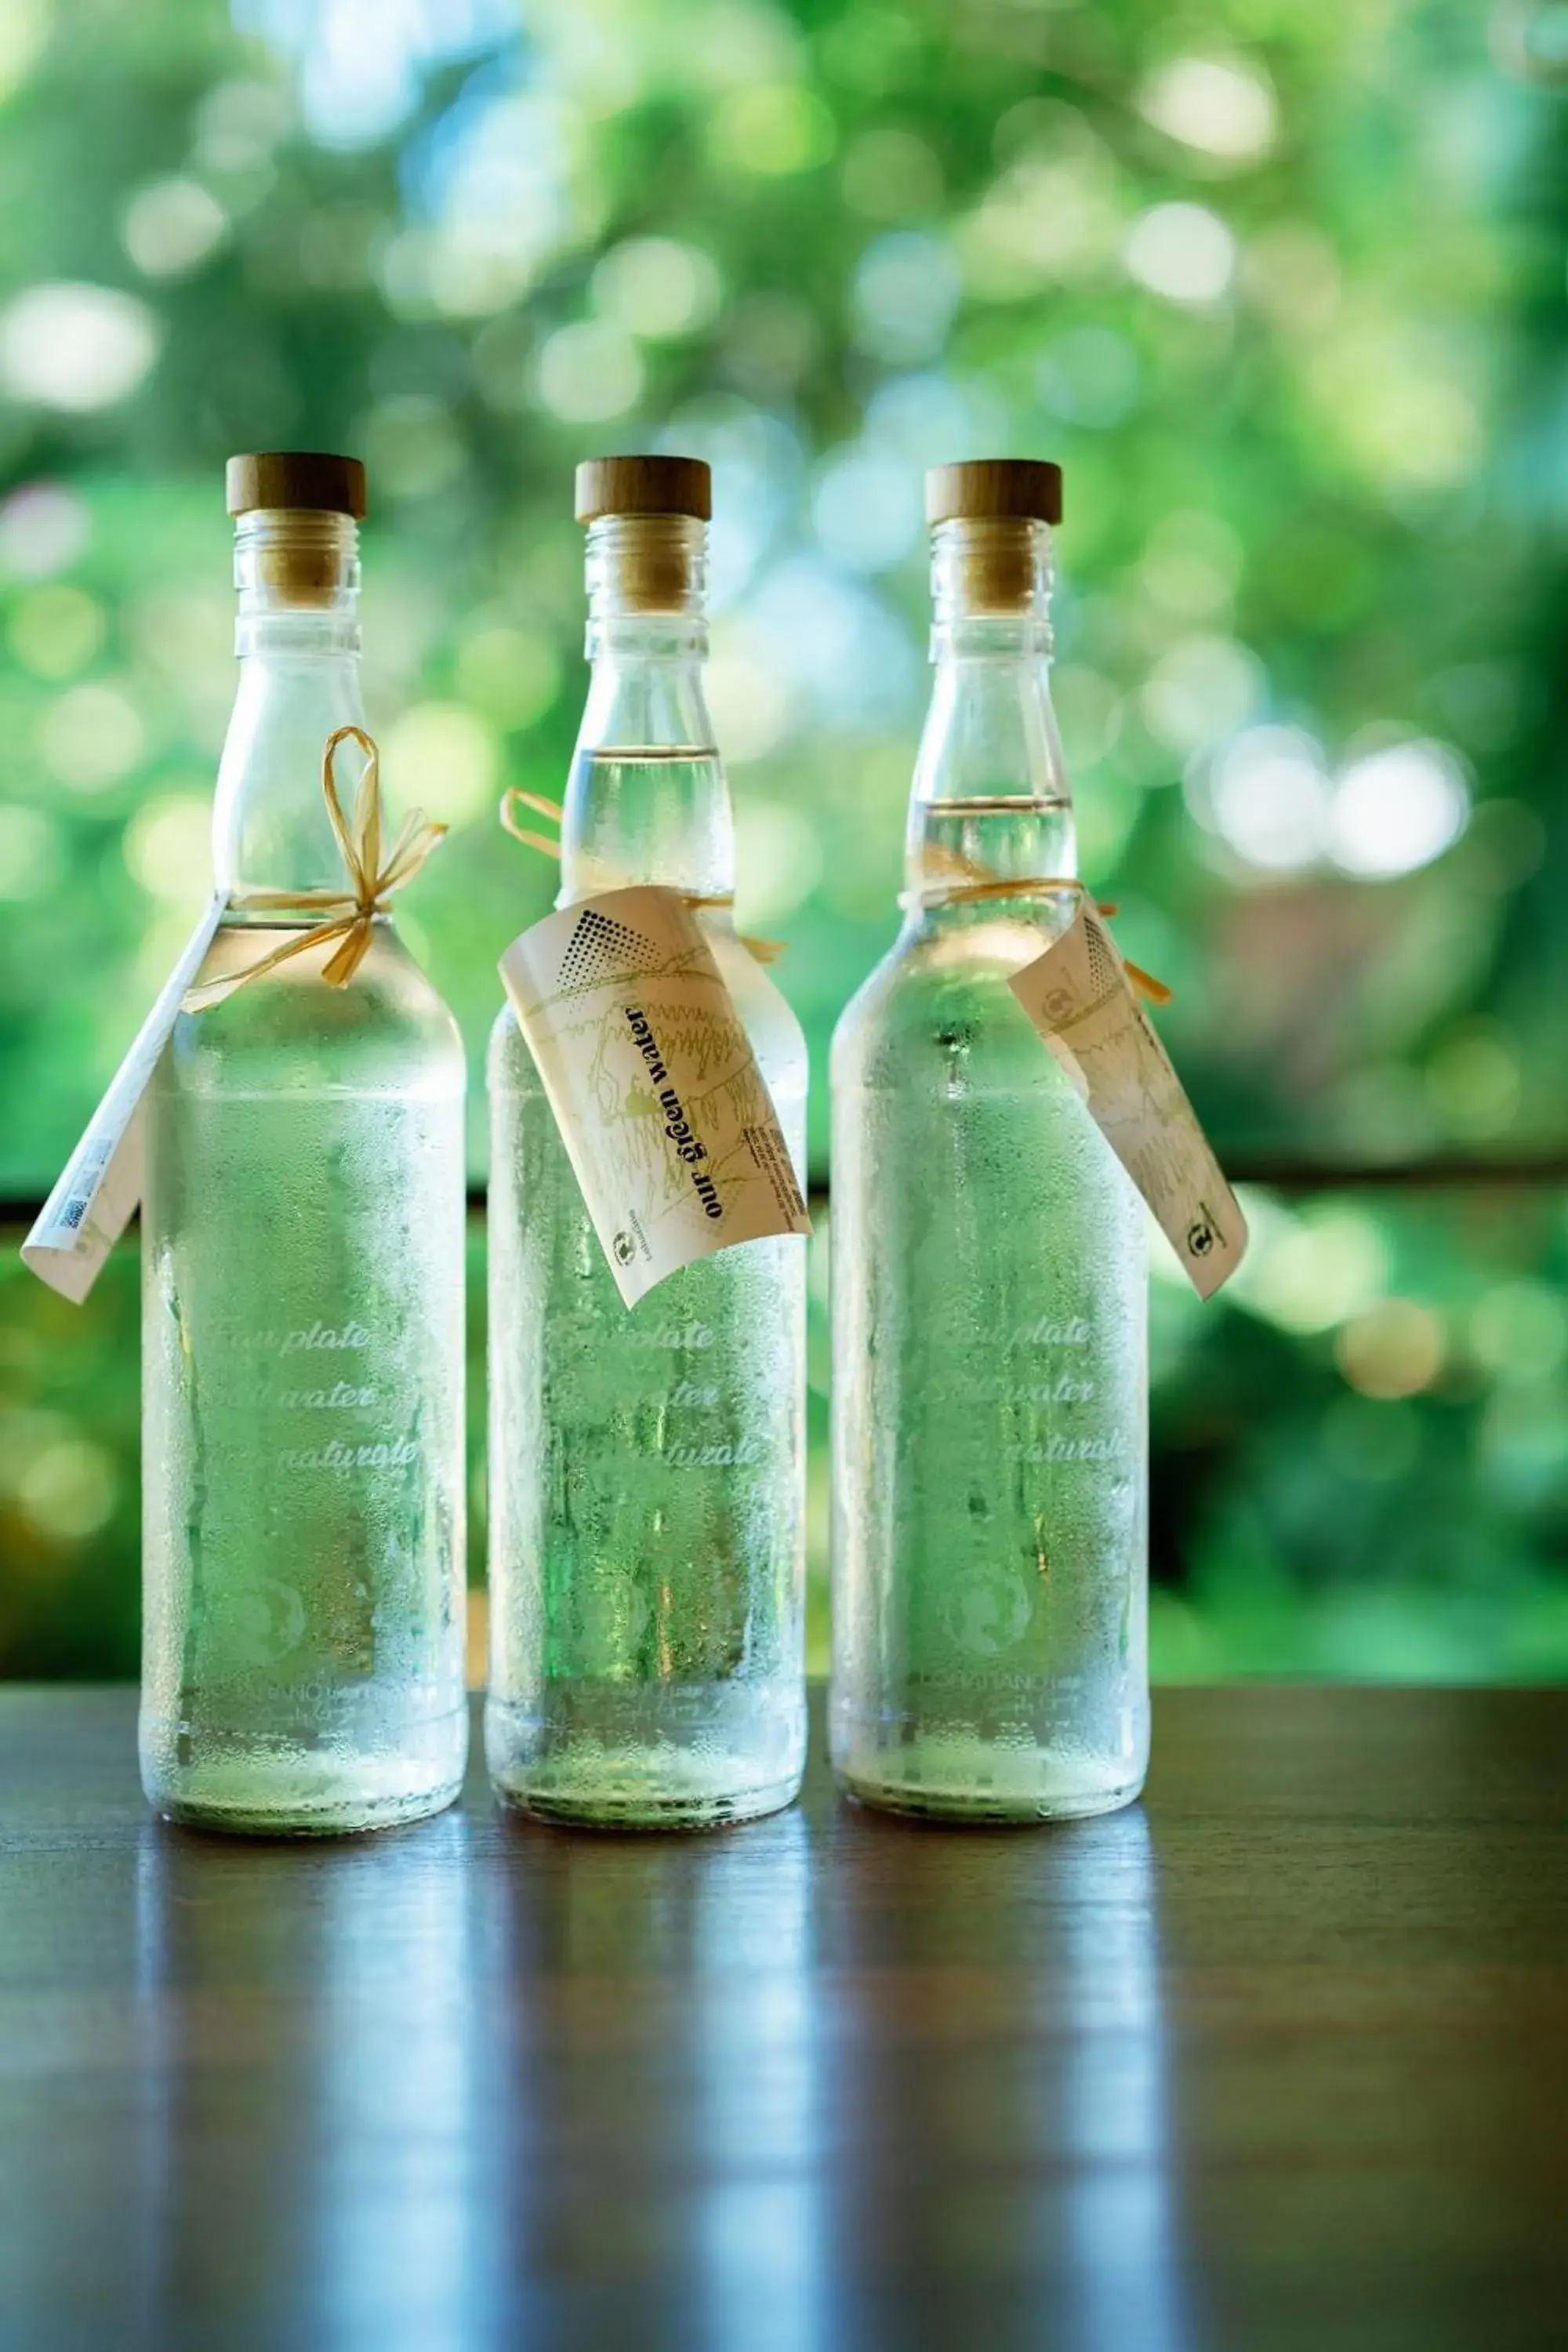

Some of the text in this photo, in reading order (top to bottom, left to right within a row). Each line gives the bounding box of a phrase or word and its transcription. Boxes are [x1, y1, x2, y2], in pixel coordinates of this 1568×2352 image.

[625, 1007, 723, 1219] our green water
[278, 1319, 372, 1358] plate
[277, 1379, 378, 1408] water
